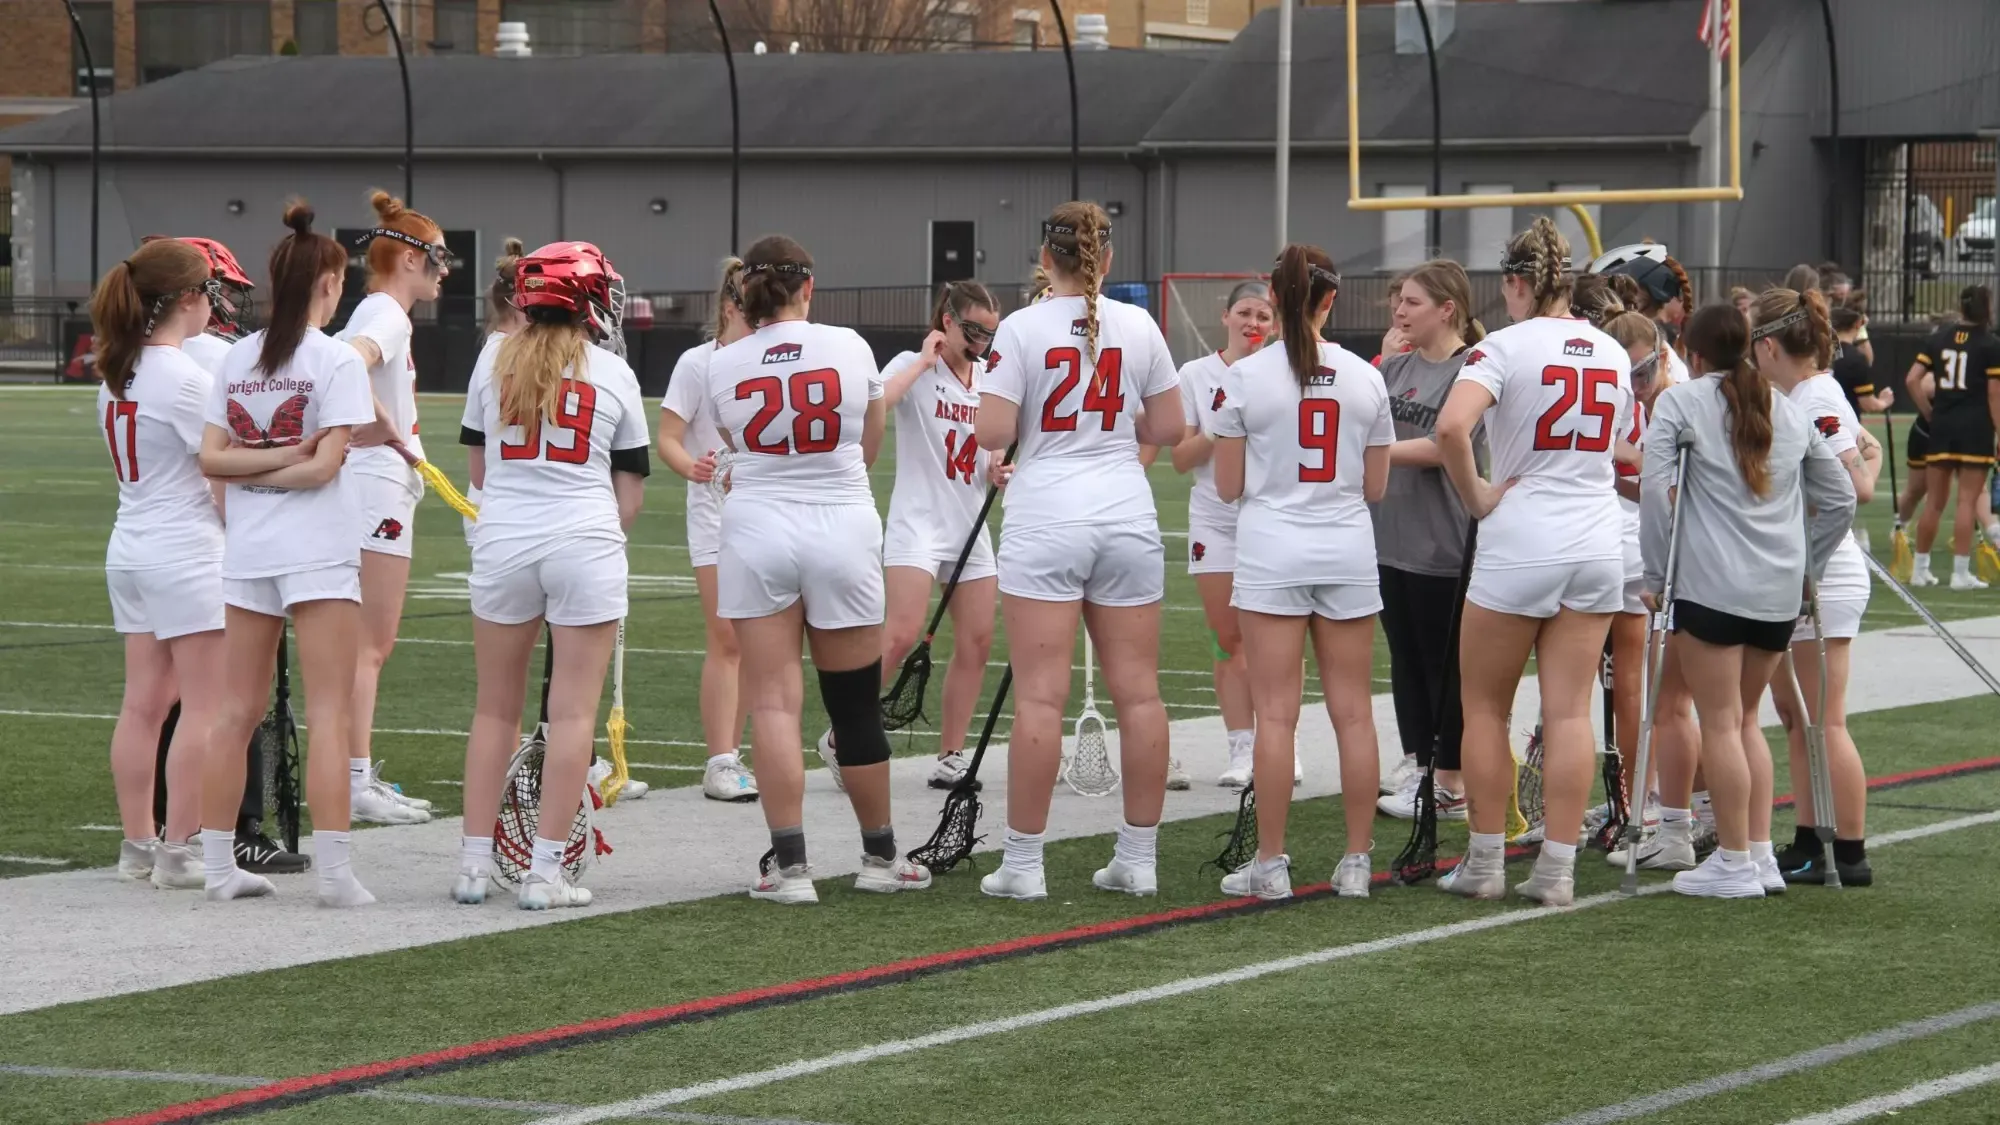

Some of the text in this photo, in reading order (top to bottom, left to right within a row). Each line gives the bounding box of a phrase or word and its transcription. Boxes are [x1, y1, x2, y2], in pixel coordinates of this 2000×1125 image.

[355, 234, 369, 245] GAIT
[385, 229, 403, 239] GAIT
[404, 235, 423, 247] GAIT
[1051, 243, 1068, 254] STX
[1072, 326, 1091, 335] MA
[1565, 345, 1593, 356] MAC
[764, 350, 800, 363] MAC
[1940, 348, 1968, 390] 31
[228, 377, 313, 396] bright College
[1041, 346, 1126, 433] 24
[735, 367, 842, 456] 28
[1532, 364, 1619, 452] 25
[105, 401, 139, 482] 17
[944, 428, 979, 485] 14
[1298, 398, 1340, 483] 9
[1603, 651, 1614, 690] STX
